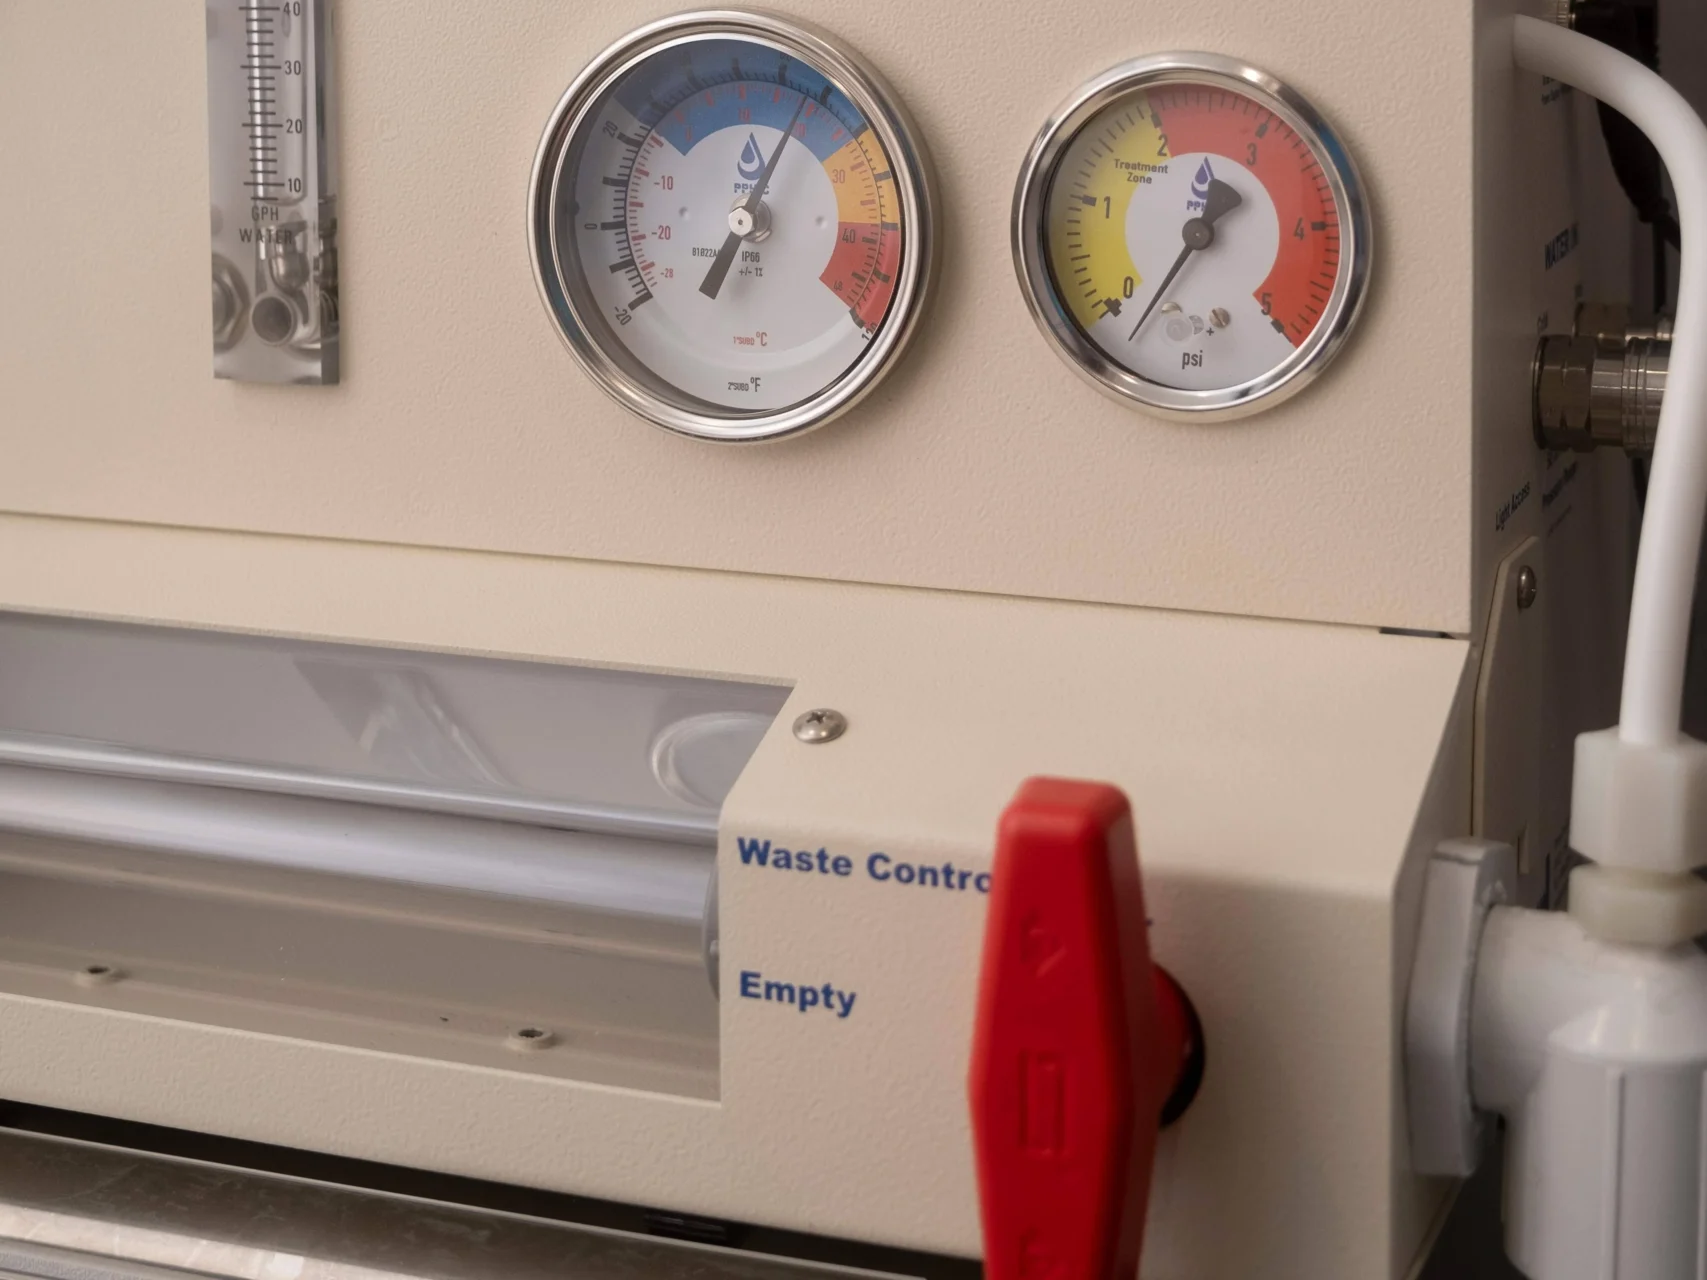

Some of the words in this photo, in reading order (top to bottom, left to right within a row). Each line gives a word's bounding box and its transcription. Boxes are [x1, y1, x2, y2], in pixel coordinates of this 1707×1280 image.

[283, 1, 301, 17] 40
[284, 60, 301, 76] 30
[286, 119, 303, 134] 20
[603, 120, 618, 138] 20
[1157, 133, 1168, 157] 2
[1246, 142, 1257, 166] 3
[1114, 158, 1169, 174] Treatment
[654, 175, 674, 191] -10
[832, 168, 846, 183] 30
[1127, 172, 1152, 185] Zone
[287, 177, 302, 193] 10
[251, 206, 279, 222] GPH
[1103, 196, 1111, 219] 1
[239, 228, 293, 245] WATER
[652, 225, 671, 240] -20
[842, 228, 856, 244] 40
[1293, 217, 1305, 240] 4
[692, 247, 720, 257] 81022A
[741, 251, 760, 263] IP66
[1122, 276, 1134, 299] 0
[1261, 292, 1272, 316] 5
[614, 306, 632, 326] -20
[1182, 350, 1203, 370] psi
[737, 837, 853, 877] Waste
[866, 852, 992, 894] Contro
[739, 970, 857, 1018] Empty
